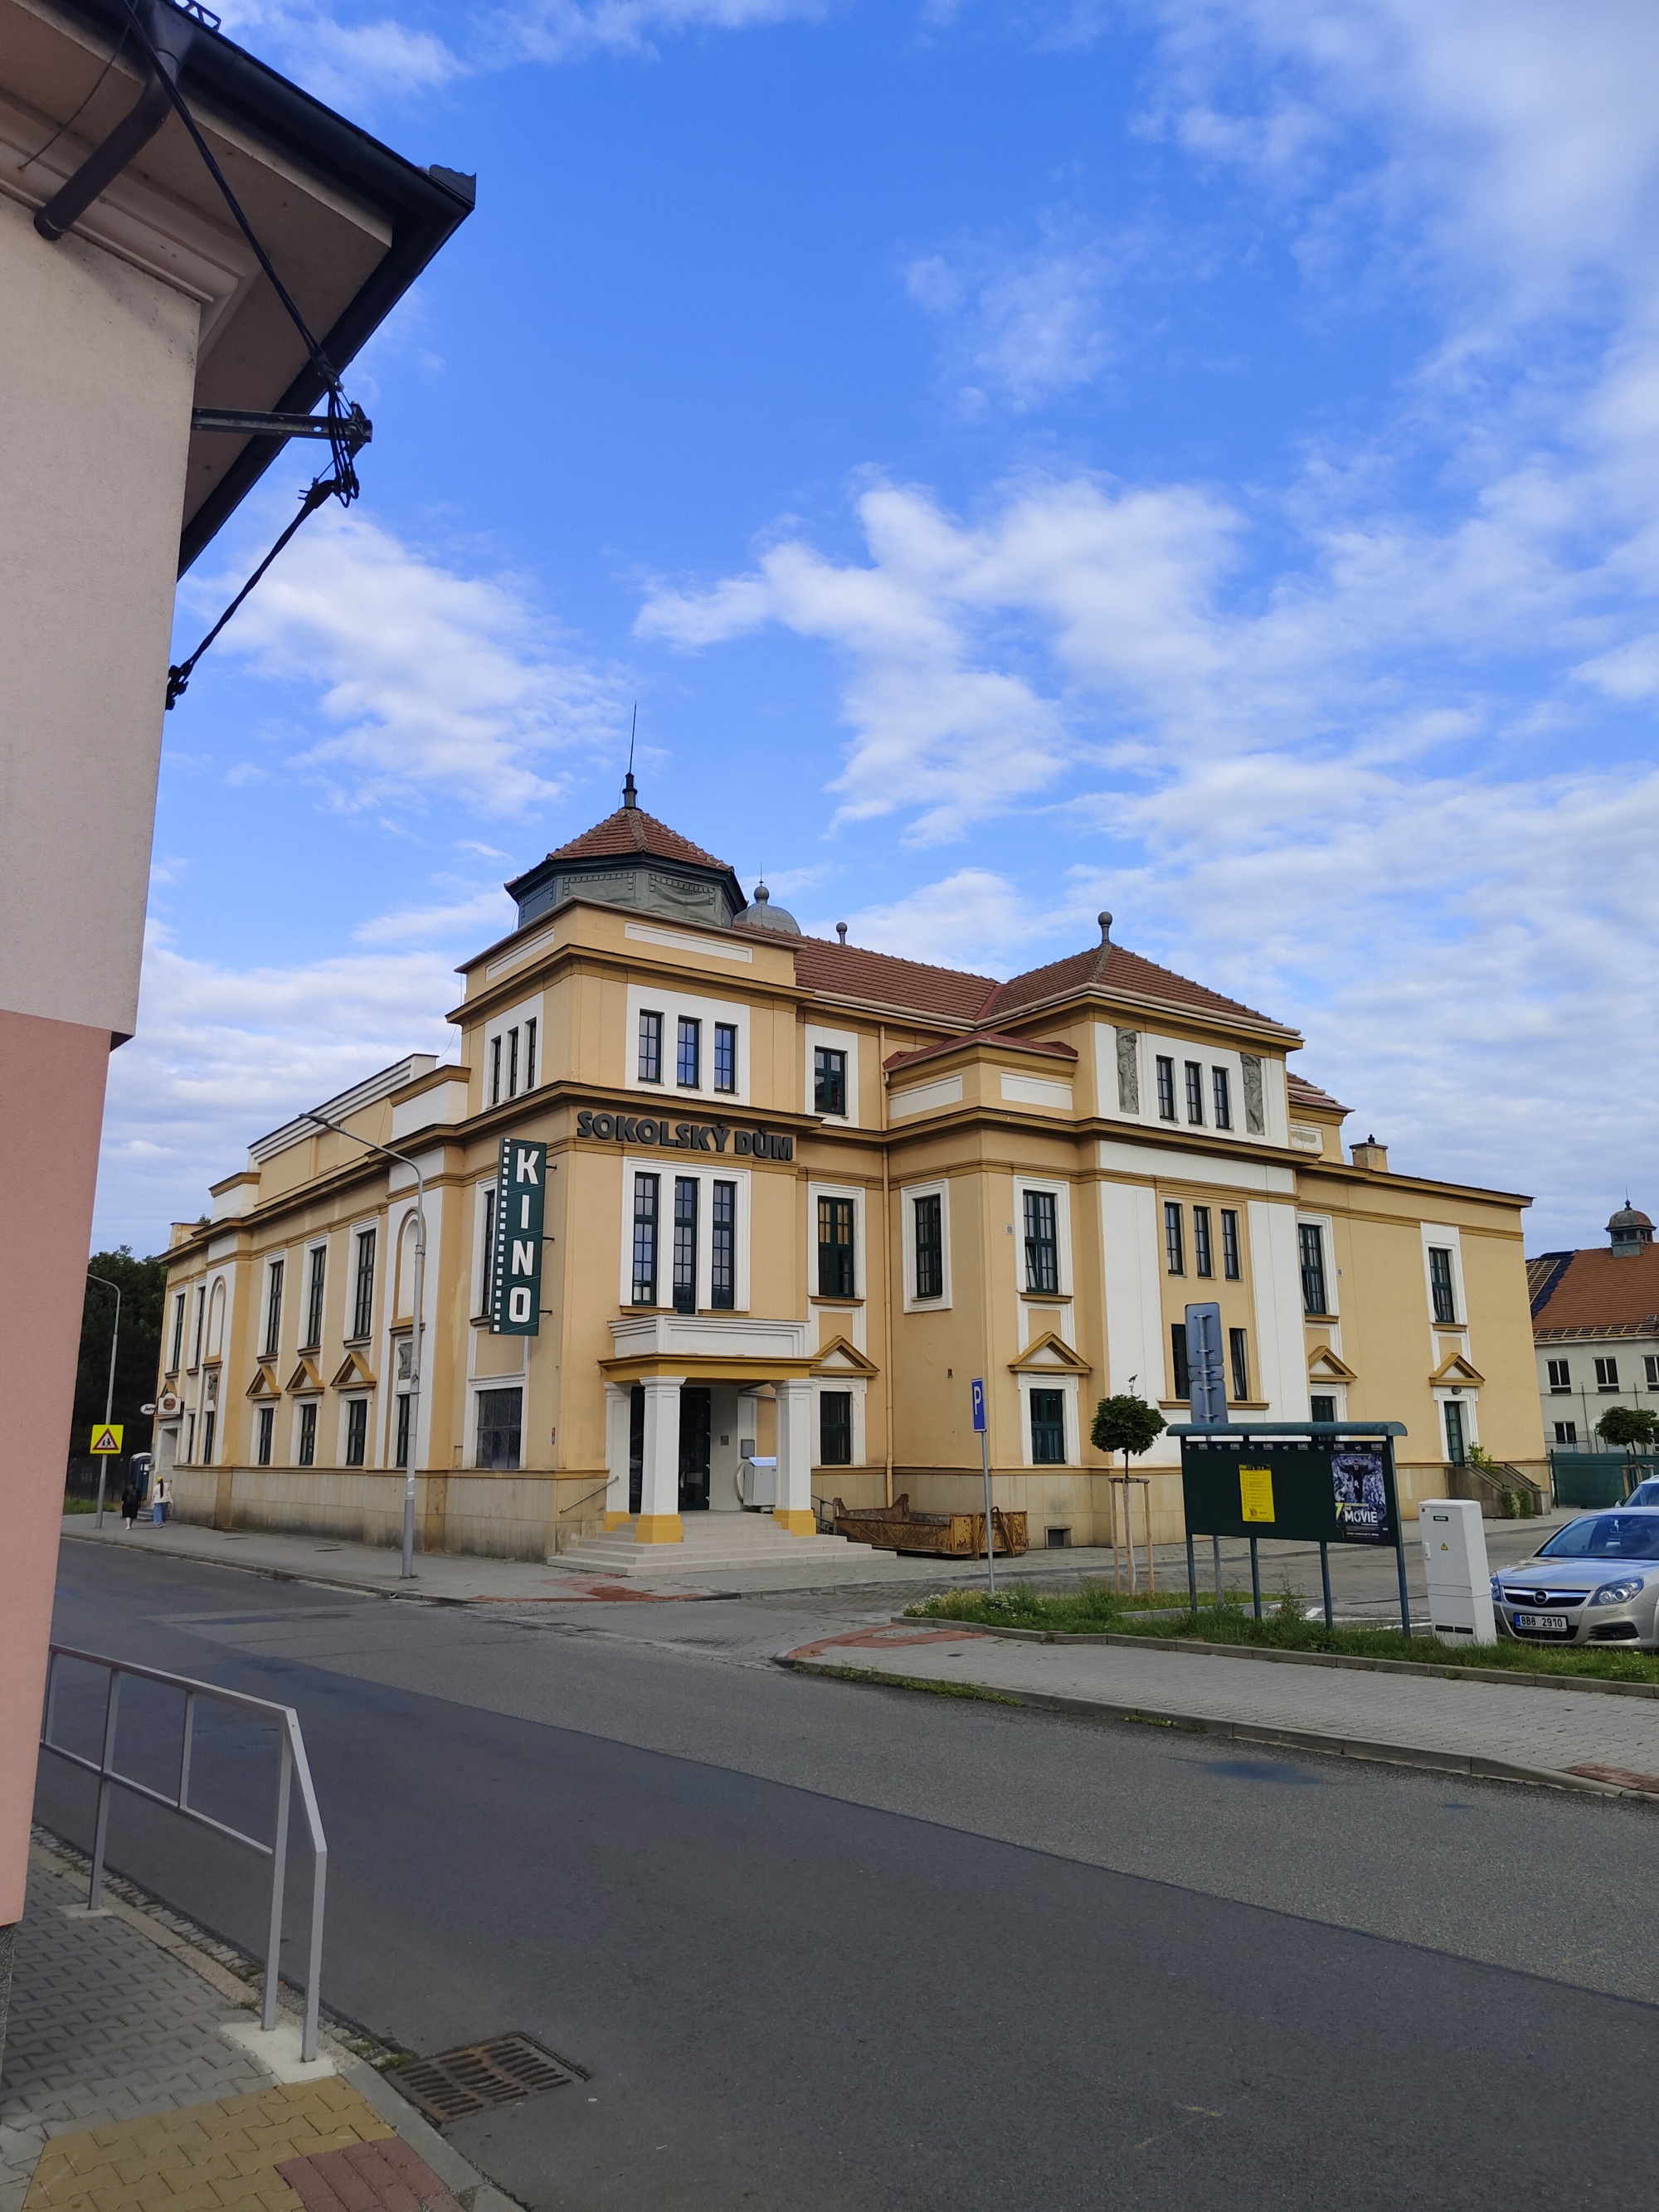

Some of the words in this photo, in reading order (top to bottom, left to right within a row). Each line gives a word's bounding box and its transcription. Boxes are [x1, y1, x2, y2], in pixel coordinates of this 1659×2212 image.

[577, 1111, 730, 1152] SOKOLSKÝ
[735, 1127, 793, 1160] DŮM
[508, 1148, 539, 1323] KINO
[974, 1386, 981, 1415] P
[1345, 1510, 1378, 1523] MOVIE
[1520, 1616, 1536, 1626] 8B8
[1542, 1618, 1563, 1627] 2910
